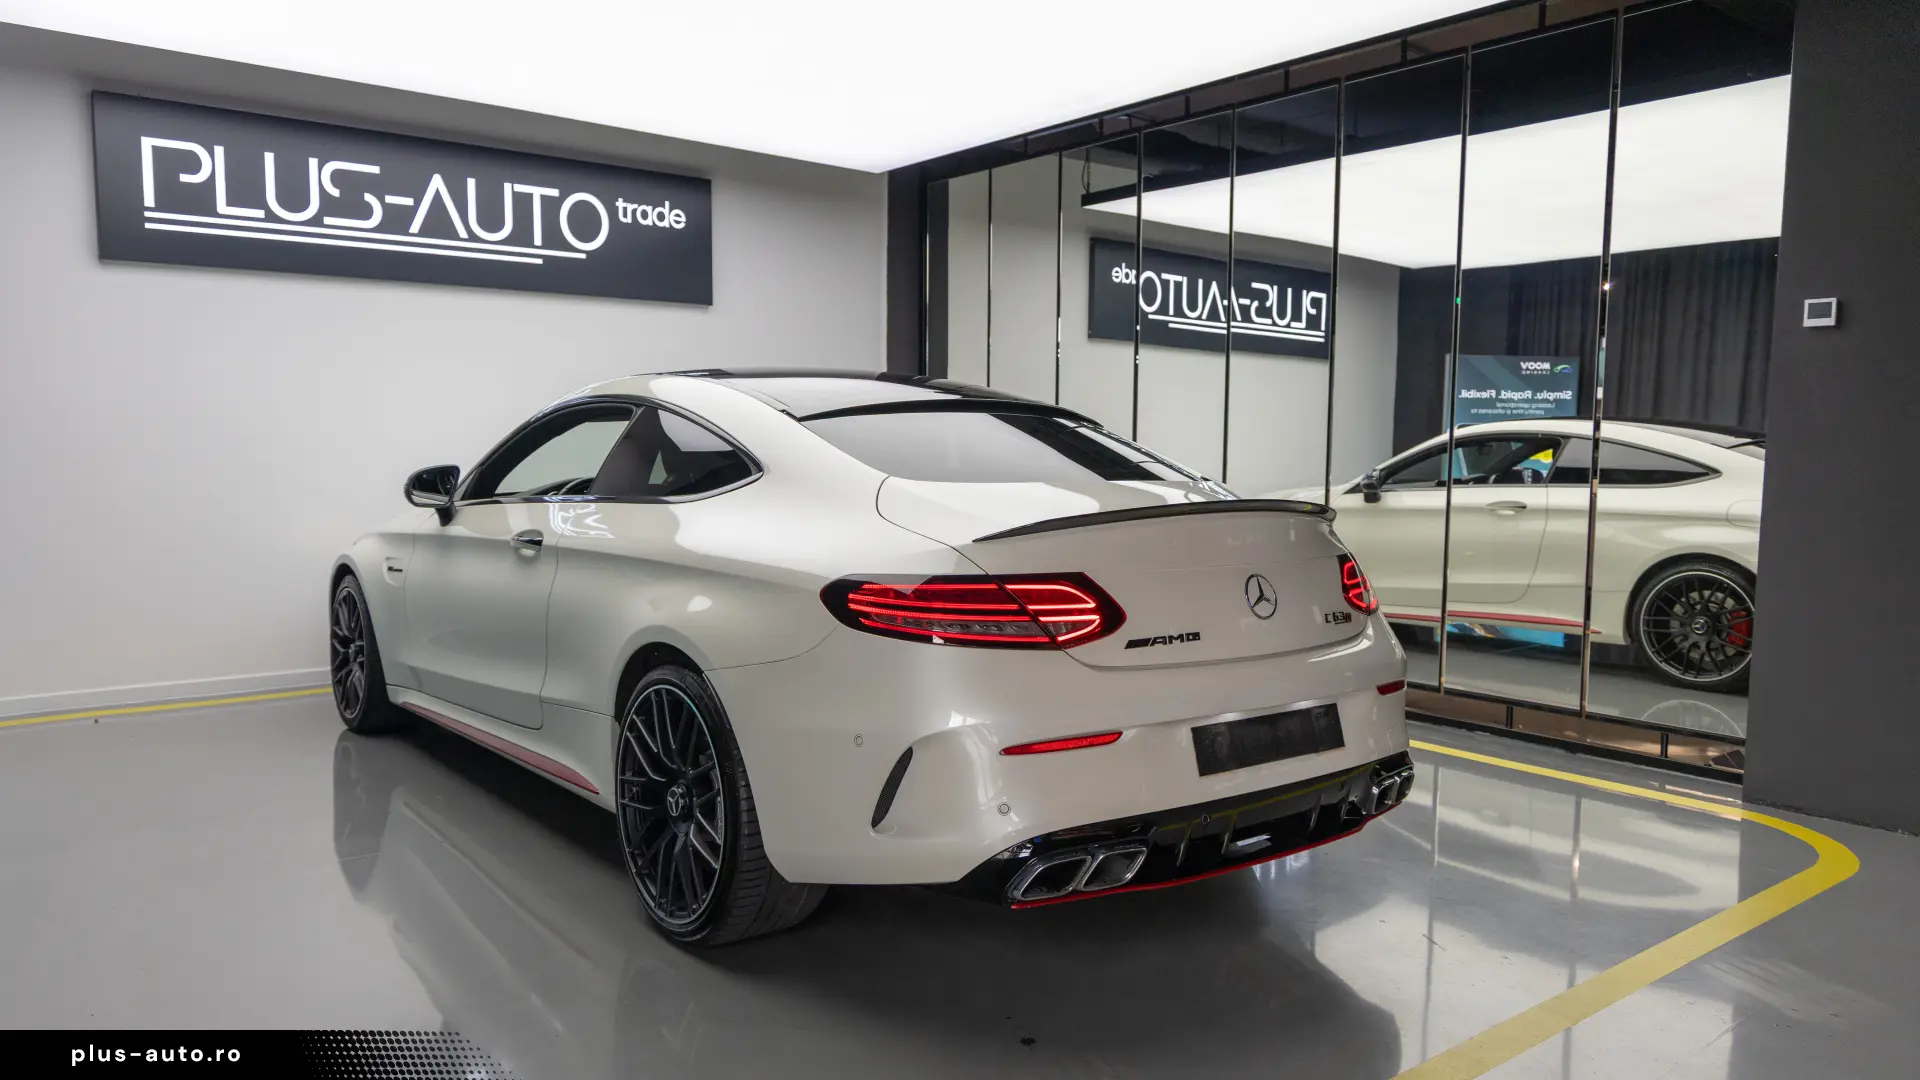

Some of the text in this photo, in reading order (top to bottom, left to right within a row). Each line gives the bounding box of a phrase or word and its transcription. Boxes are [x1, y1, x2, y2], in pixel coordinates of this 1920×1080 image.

[140, 135, 686, 251] PLUS-AUTO trade
[1149, 631, 1201, 647] AMG
